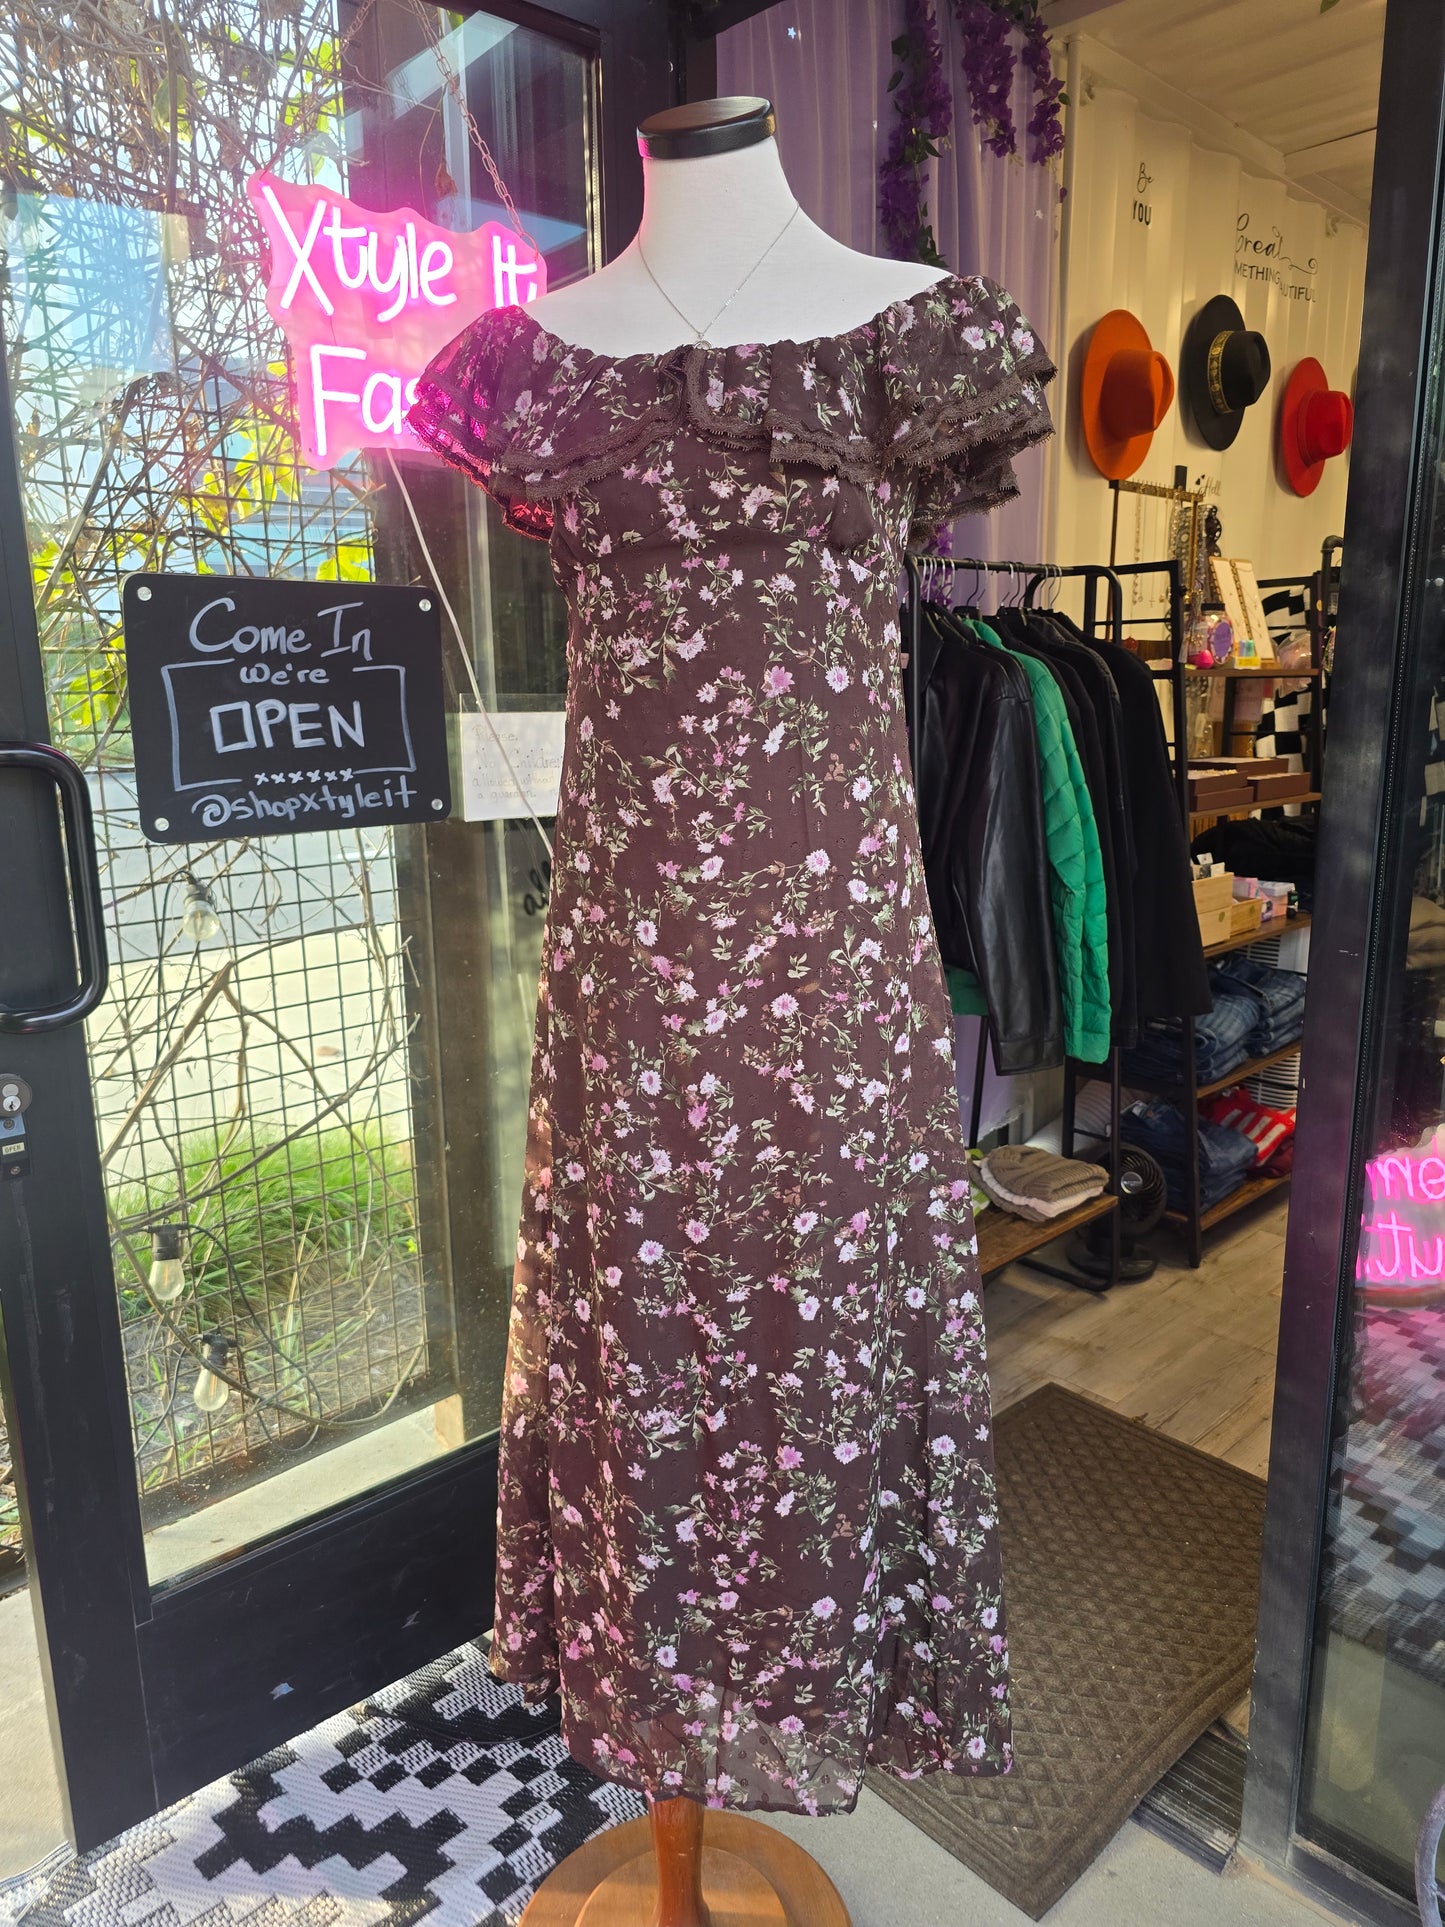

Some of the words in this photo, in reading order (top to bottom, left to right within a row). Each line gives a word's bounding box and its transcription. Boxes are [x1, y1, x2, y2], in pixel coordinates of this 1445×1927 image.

[1137, 162, 1153, 193] Be
[1132, 200, 1152, 226] YOU
[261, 185, 457, 322] Xtyle
[492, 235, 537, 309] It
[189, 597, 312, 654] Come
[317, 602, 373, 661] In
[209, 699, 365, 754] OPEN
[5, 1144, 21, 1153] OPEN
